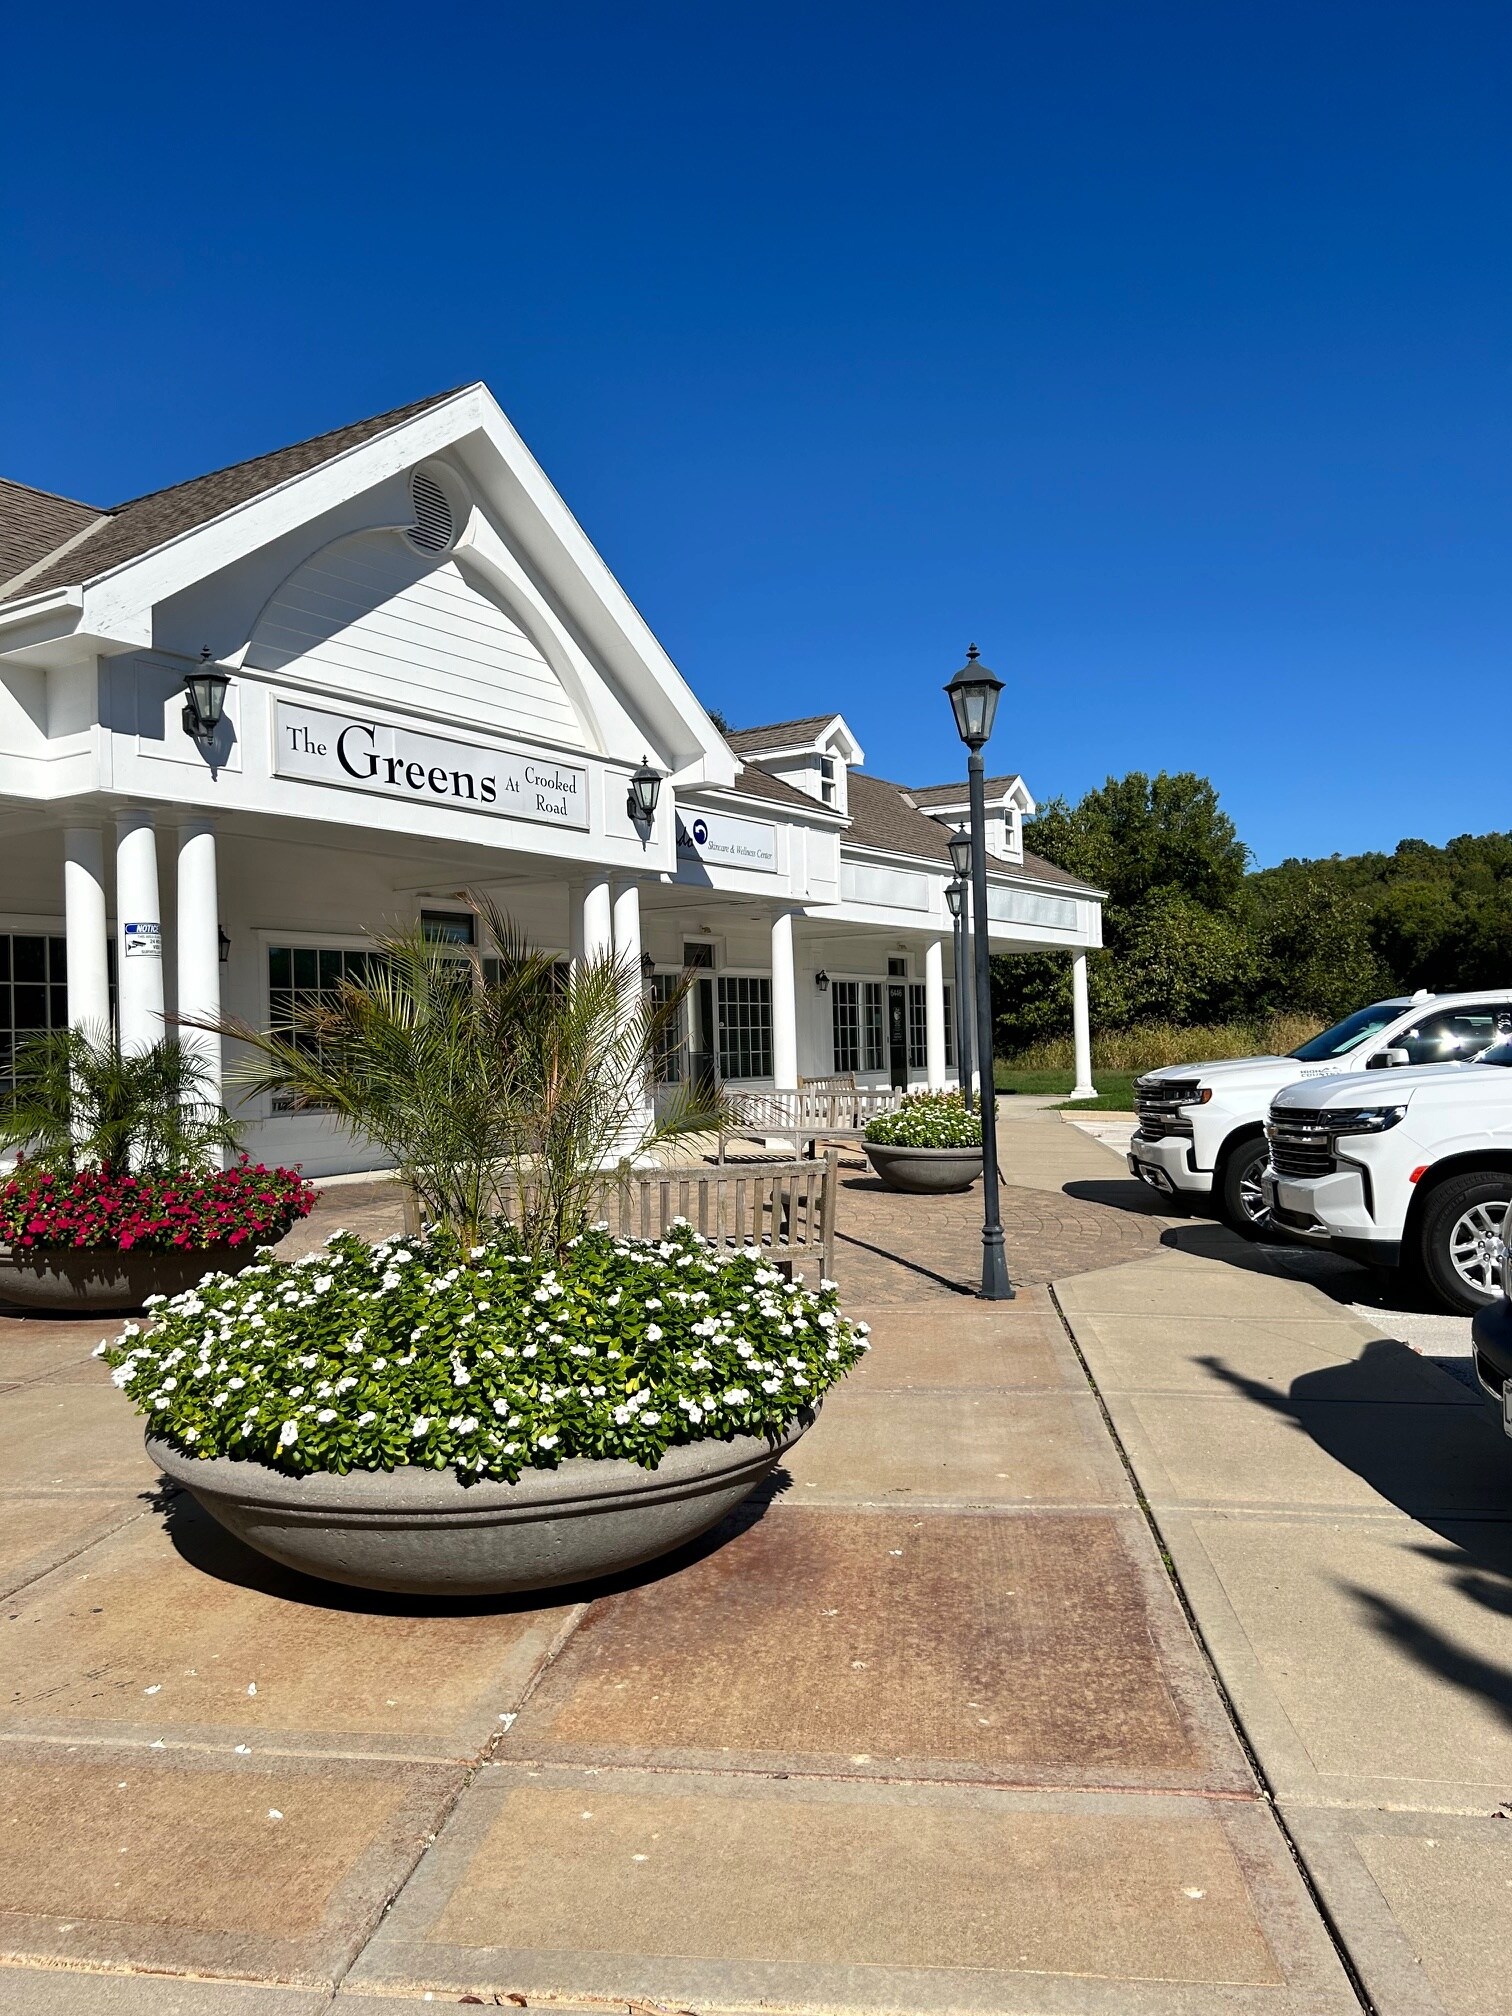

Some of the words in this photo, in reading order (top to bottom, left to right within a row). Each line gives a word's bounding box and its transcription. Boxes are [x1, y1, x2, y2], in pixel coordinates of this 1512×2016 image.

[286, 725, 327, 755] The
[336, 724, 497, 802] Greens
[505, 776, 520, 793] At
[524, 766, 577, 794] Crooked
[535, 794, 568, 816] Road
[708, 840, 729, 853] Skincare
[730, 844, 735, 854] &
[736, 845, 756, 858] Wellness
[757, 849, 773, 860] Center
